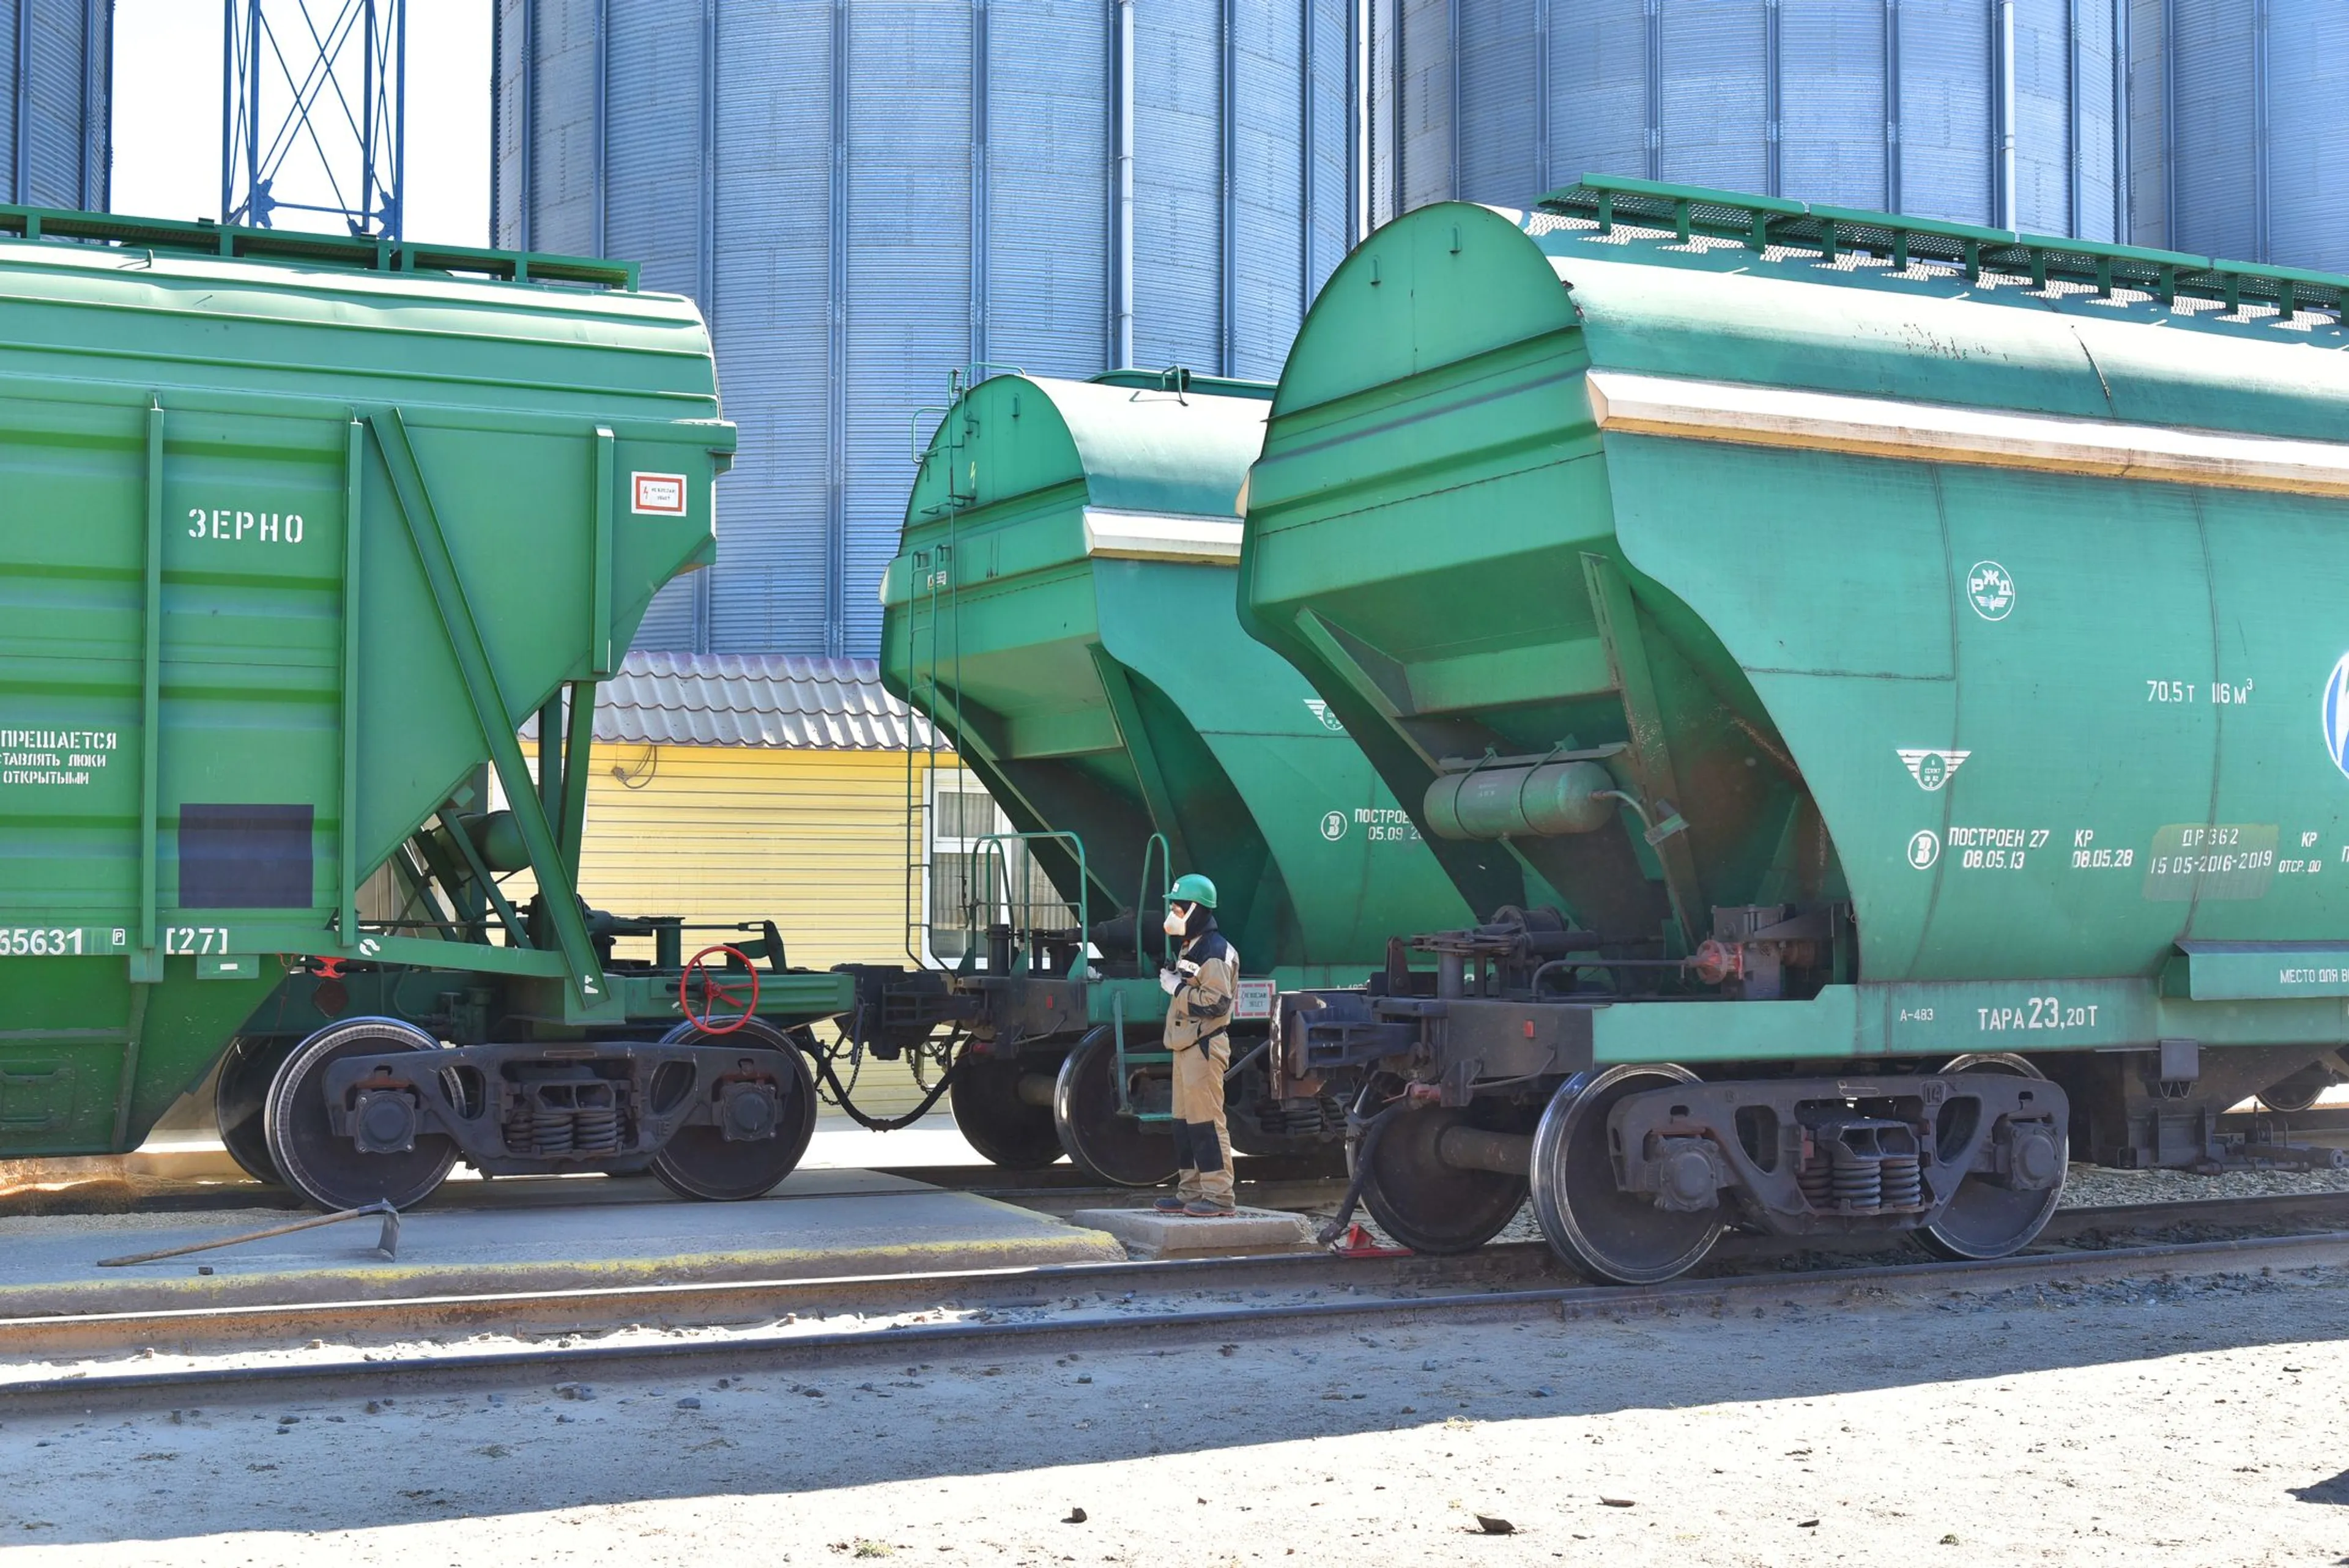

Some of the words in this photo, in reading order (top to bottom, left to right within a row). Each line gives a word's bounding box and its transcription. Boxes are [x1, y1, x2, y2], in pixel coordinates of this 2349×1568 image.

[188, 509, 303, 542] ЗЕРНО
[1971, 569, 2012, 595] РЖД
[1, 730, 117, 749] ПРЕЩАЕТСЯ
[68, 753, 106, 767] ЛЮКИ
[2, 771, 89, 784] ОТКРЫТЫМИ
[1354, 808, 1412, 824] ПОСТРОЕ
[1948, 827, 2025, 847] ПОСТРОЕН
[2028, 830, 2049, 848] 27
[2074, 830, 2093, 848] КР
[2301, 832, 2317, 847] КР
[1962, 849, 2025, 869] 08.05.13
[2071, 849, 2133, 868] 08.05.28
[2280, 969, 2315, 983] МЕСТО
[1900, 1008, 1933, 1022] А-483
[1978, 1008, 2025, 1030] ТАРА
